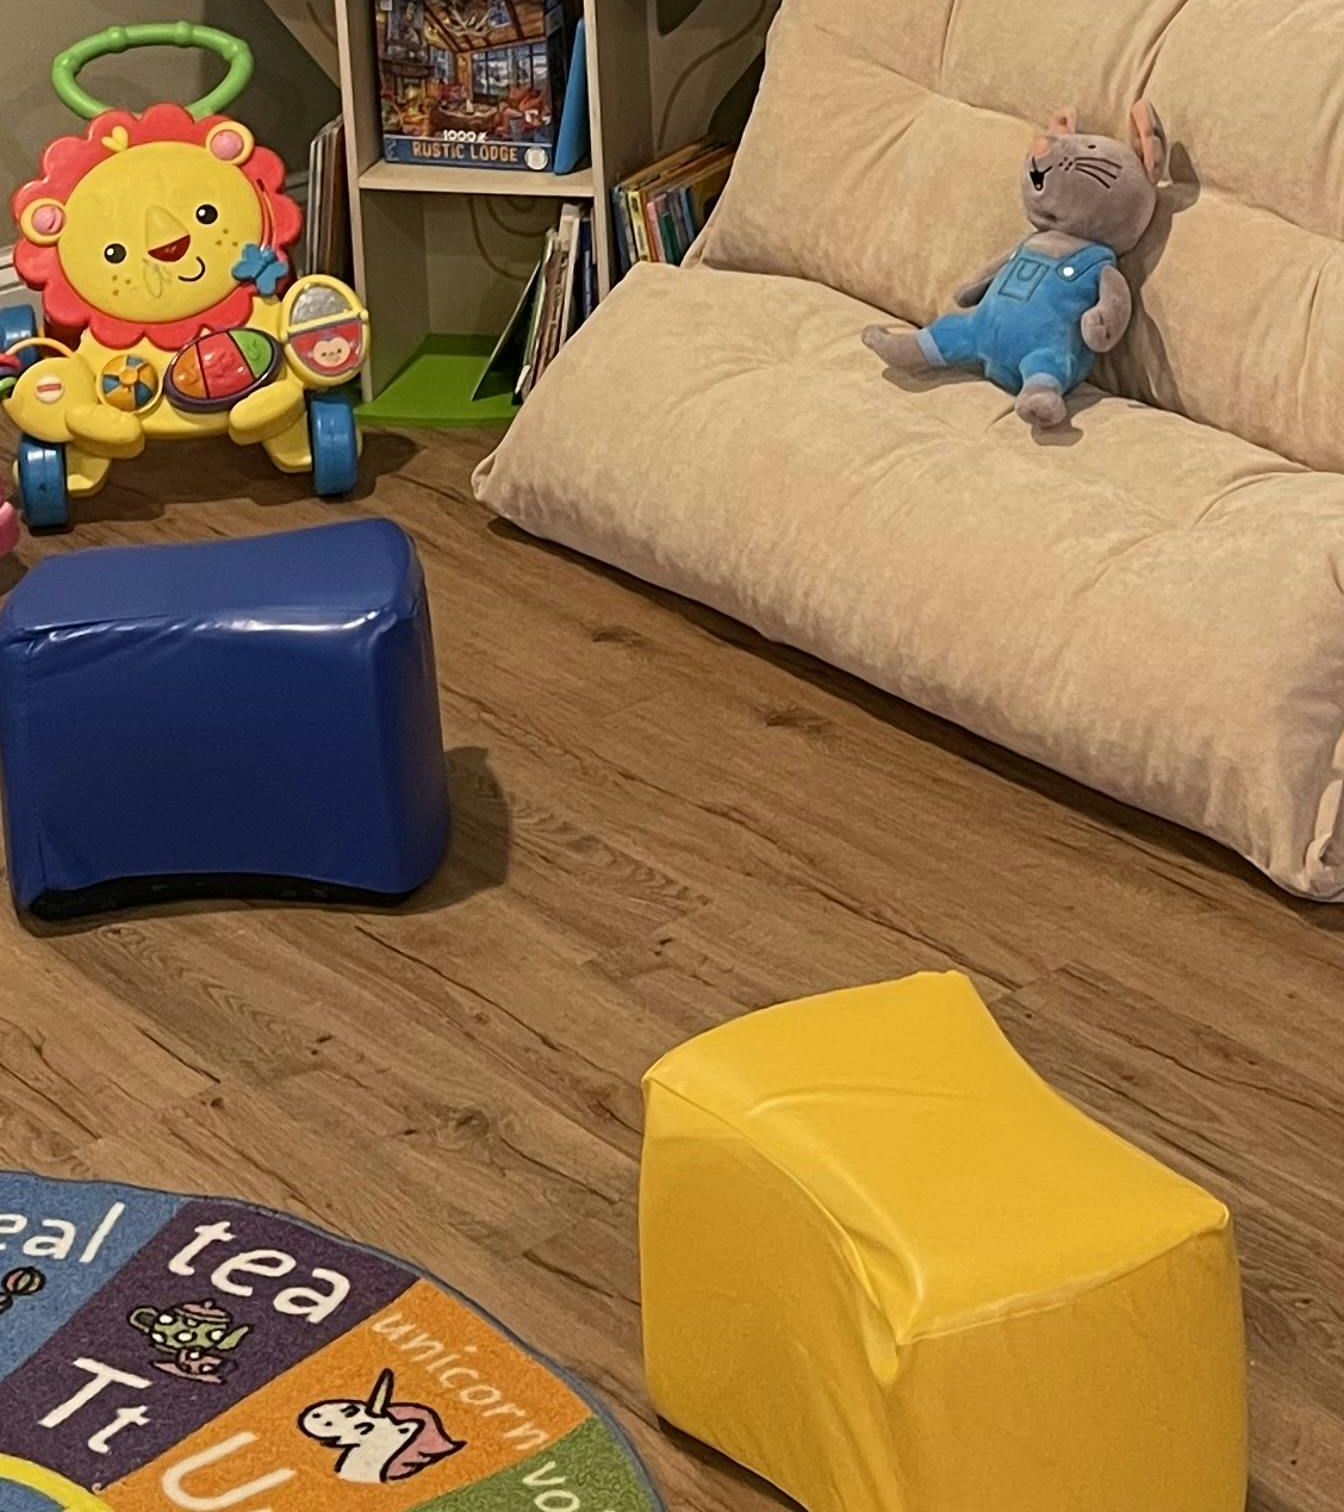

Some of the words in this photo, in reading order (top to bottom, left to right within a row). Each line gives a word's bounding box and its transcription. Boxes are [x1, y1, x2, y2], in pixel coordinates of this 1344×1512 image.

[412, 141, 465, 159] RUSTIC
[470, 144, 518, 162] LODGE
[166, 1220, 352, 1325] tea
[38, 1356, 152, 1456] Tt
[371, 1310, 551, 1451] unicorn
[160, 1431, 297, 1512] U
